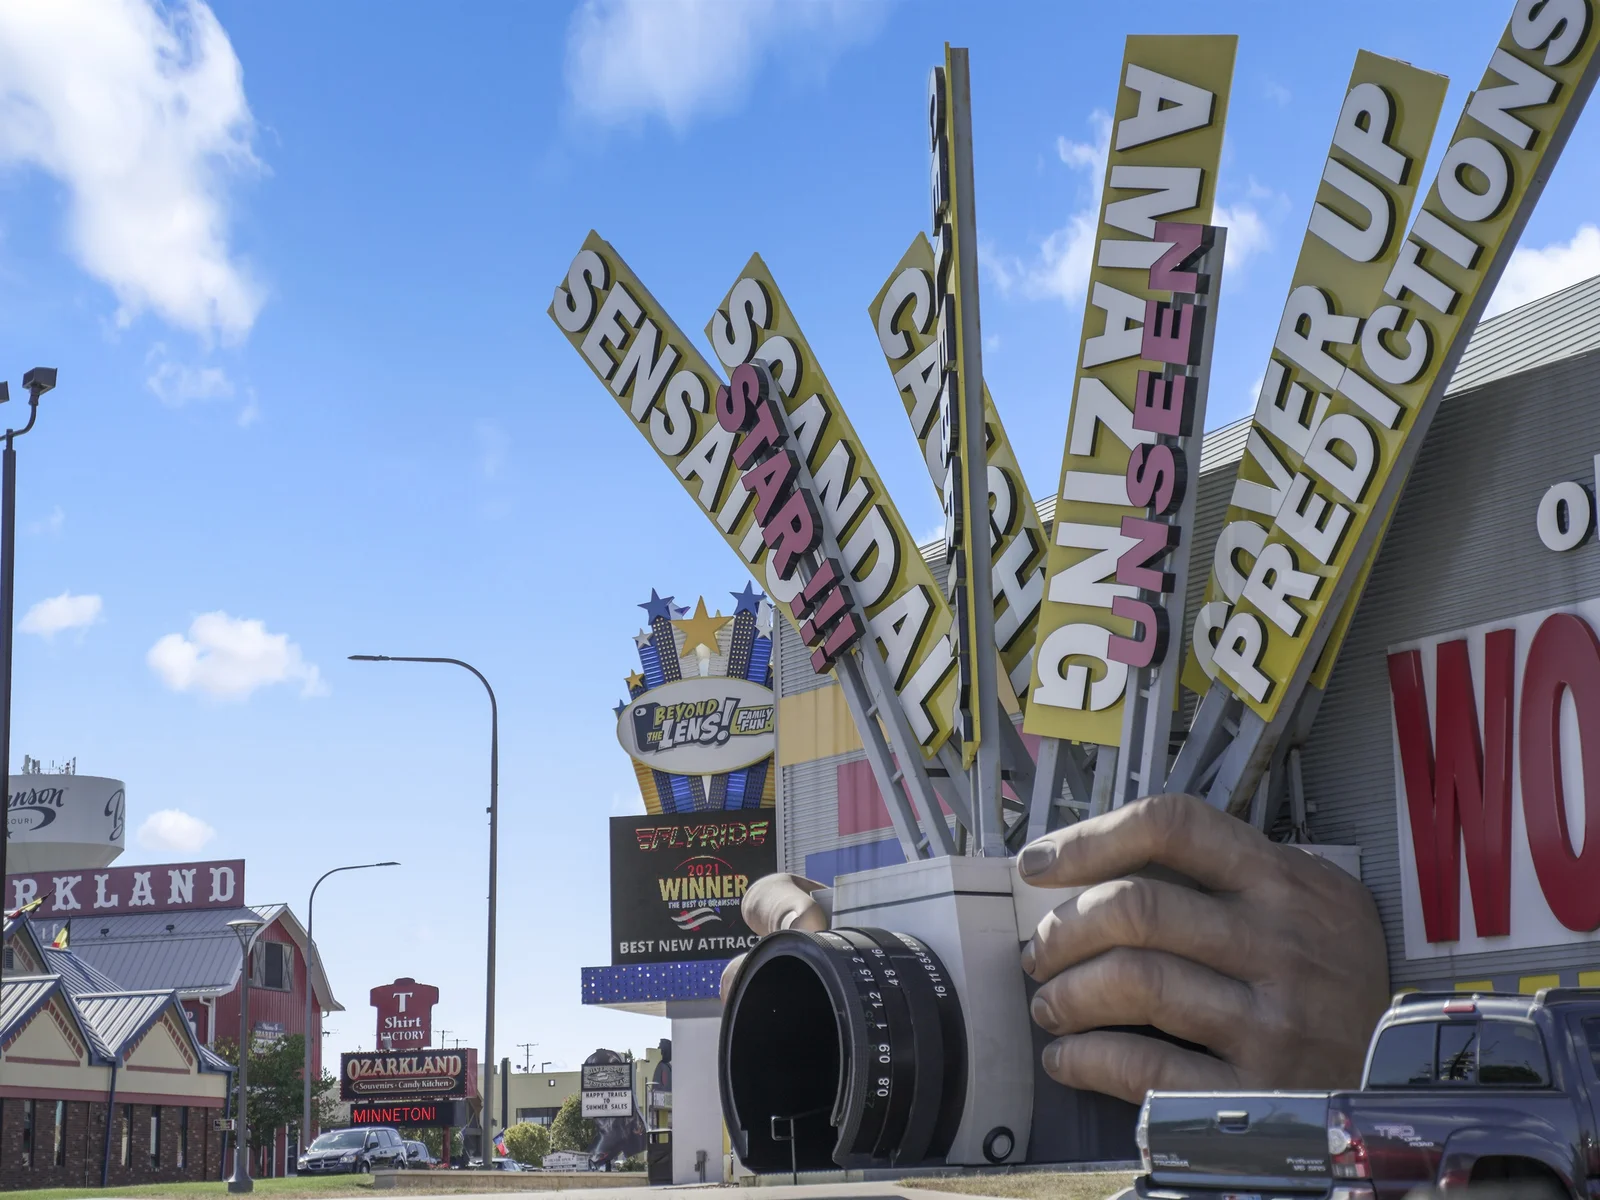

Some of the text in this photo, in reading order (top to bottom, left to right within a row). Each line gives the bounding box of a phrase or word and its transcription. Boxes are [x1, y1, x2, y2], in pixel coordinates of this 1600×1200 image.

[1212, 0, 1593, 703] PREDICTIONS
[1033, 62, 1215, 711] AMAZING
[1193, 82, 1416, 681] COVER UP
[1108, 221, 1215, 669] UNSEEN
[654, 699, 719, 726] BEYOND
[738, 708, 774, 724] FAMILY
[648, 699, 738, 750] THE LENS!
[741, 718, 765, 732] FUN
[1387, 613, 1600, 942] WO
[687, 864, 720, 877] 2021
[658, 874, 749, 901] WINNER
[681, 901, 697, 909] BEST
[698, 900, 707, 908] OF
[707, 898, 740, 907] BRANSON
[620, 940, 654, 954] BEST
[659, 938, 694, 952] NEW
[852, 956, 865, 964] 2
[860, 969, 875, 982] 1.5
[929, 973, 942, 983] 11
[934, 985, 948, 999] 16
[392, 992, 414, 1013] T
[869, 992, 884, 1009] 1.2
[384, 1016, 422, 1028] Shirt
[380, 1030, 425, 1042] FACTORY
[878, 1044, 891, 1064] 0.9
[346, 1055, 462, 1081] OZARKLAND
[359, 1080, 449, 1090] Souvenirs Candy Kitchen
[877, 1077, 890, 1097] 0.8
[1374, 1125, 1415, 1139] TRD
